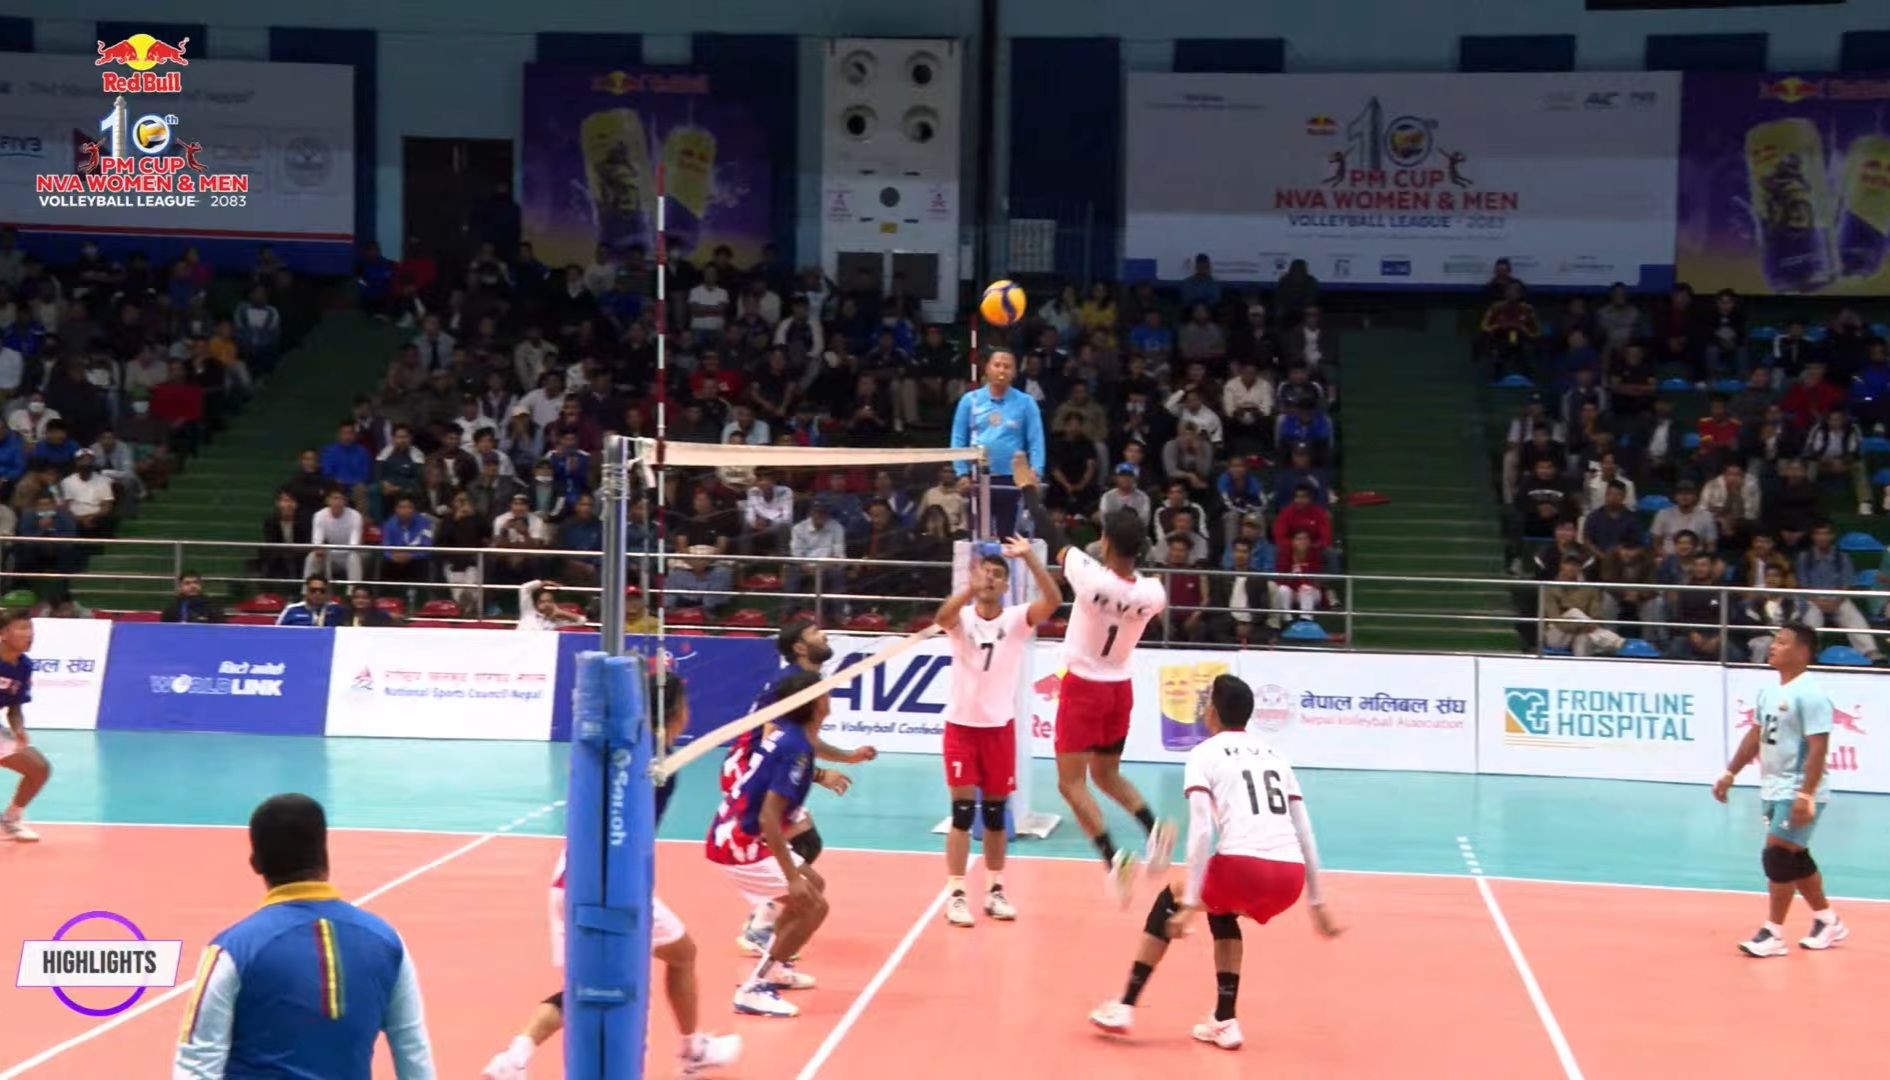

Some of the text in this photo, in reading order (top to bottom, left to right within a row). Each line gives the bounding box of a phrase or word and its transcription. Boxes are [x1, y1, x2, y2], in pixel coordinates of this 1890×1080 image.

[1350, 168, 1445, 189] PM CUP
[1275, 187, 1520, 211] NVA WOMEN & MEN
[1288, 213, 1386, 228] VOLLEYBALL
[1101, 624, 1119, 657] 1
[981, 642, 994, 671] 7
[1301, 690, 1352, 712] नेपाल
[1436, 697, 1466, 715] संघ
[1557, 689, 1695, 716] FRONTLINE
[841, 721, 896, 736] Volleyball
[898, 723, 945, 735] Confede
[1031, 714, 1056, 739] Re
[1557, 713, 1695, 742] HOSPITAL
[952, 761, 963, 779] 7
[1241, 769, 1287, 816] 16
